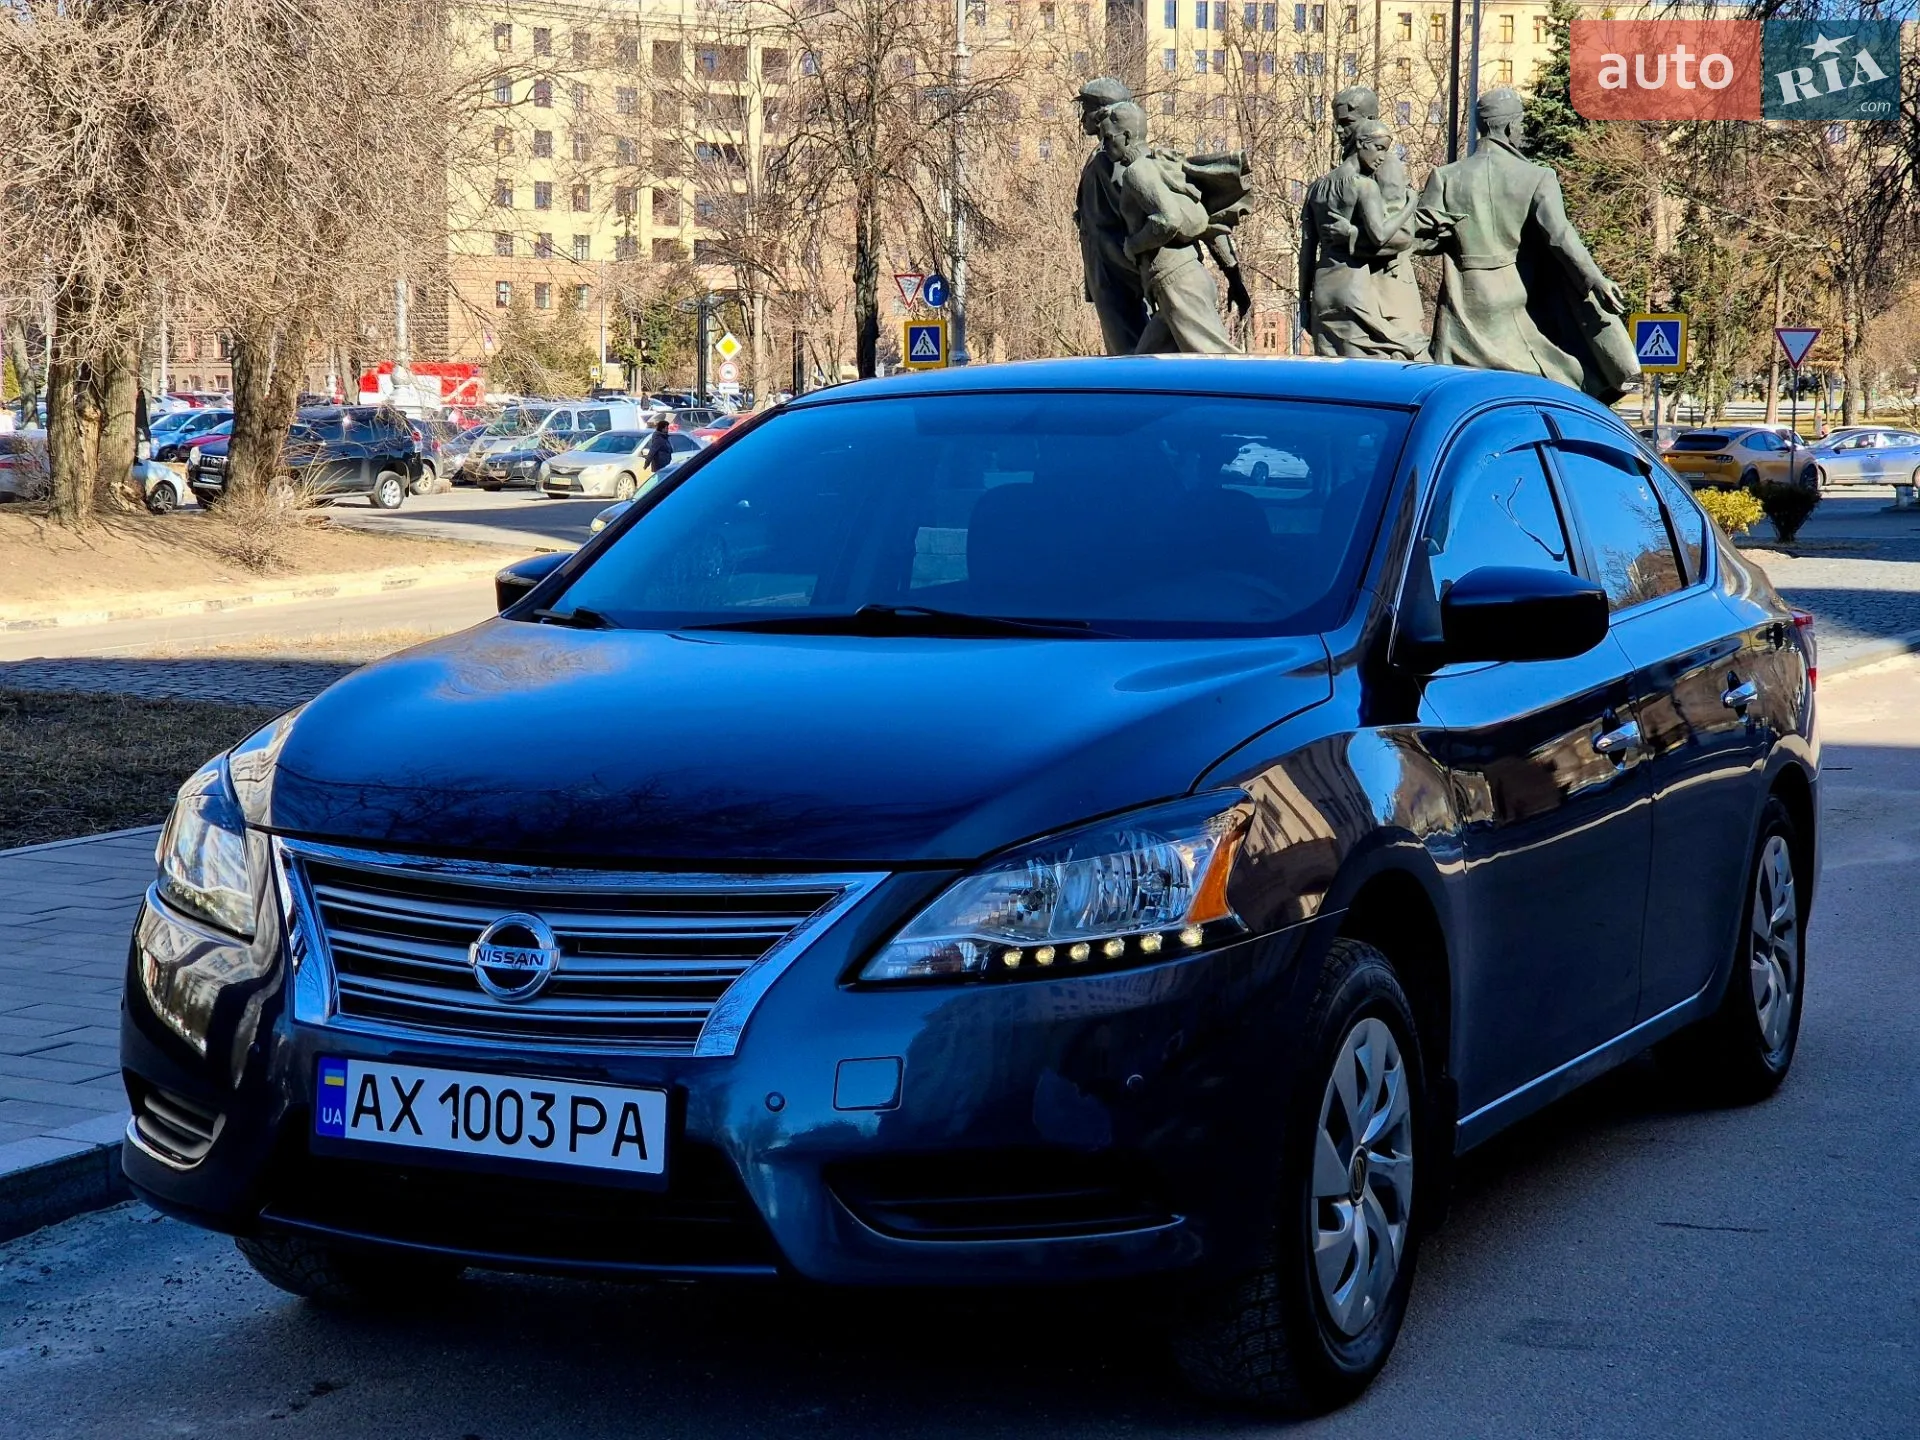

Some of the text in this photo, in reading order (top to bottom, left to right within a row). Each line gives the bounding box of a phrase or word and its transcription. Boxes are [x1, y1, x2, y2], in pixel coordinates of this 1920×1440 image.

[475, 948, 545, 967] NISSAN
[322, 1107, 343, 1126] UA
[351, 1073, 648, 1161] AX 1003 PA
